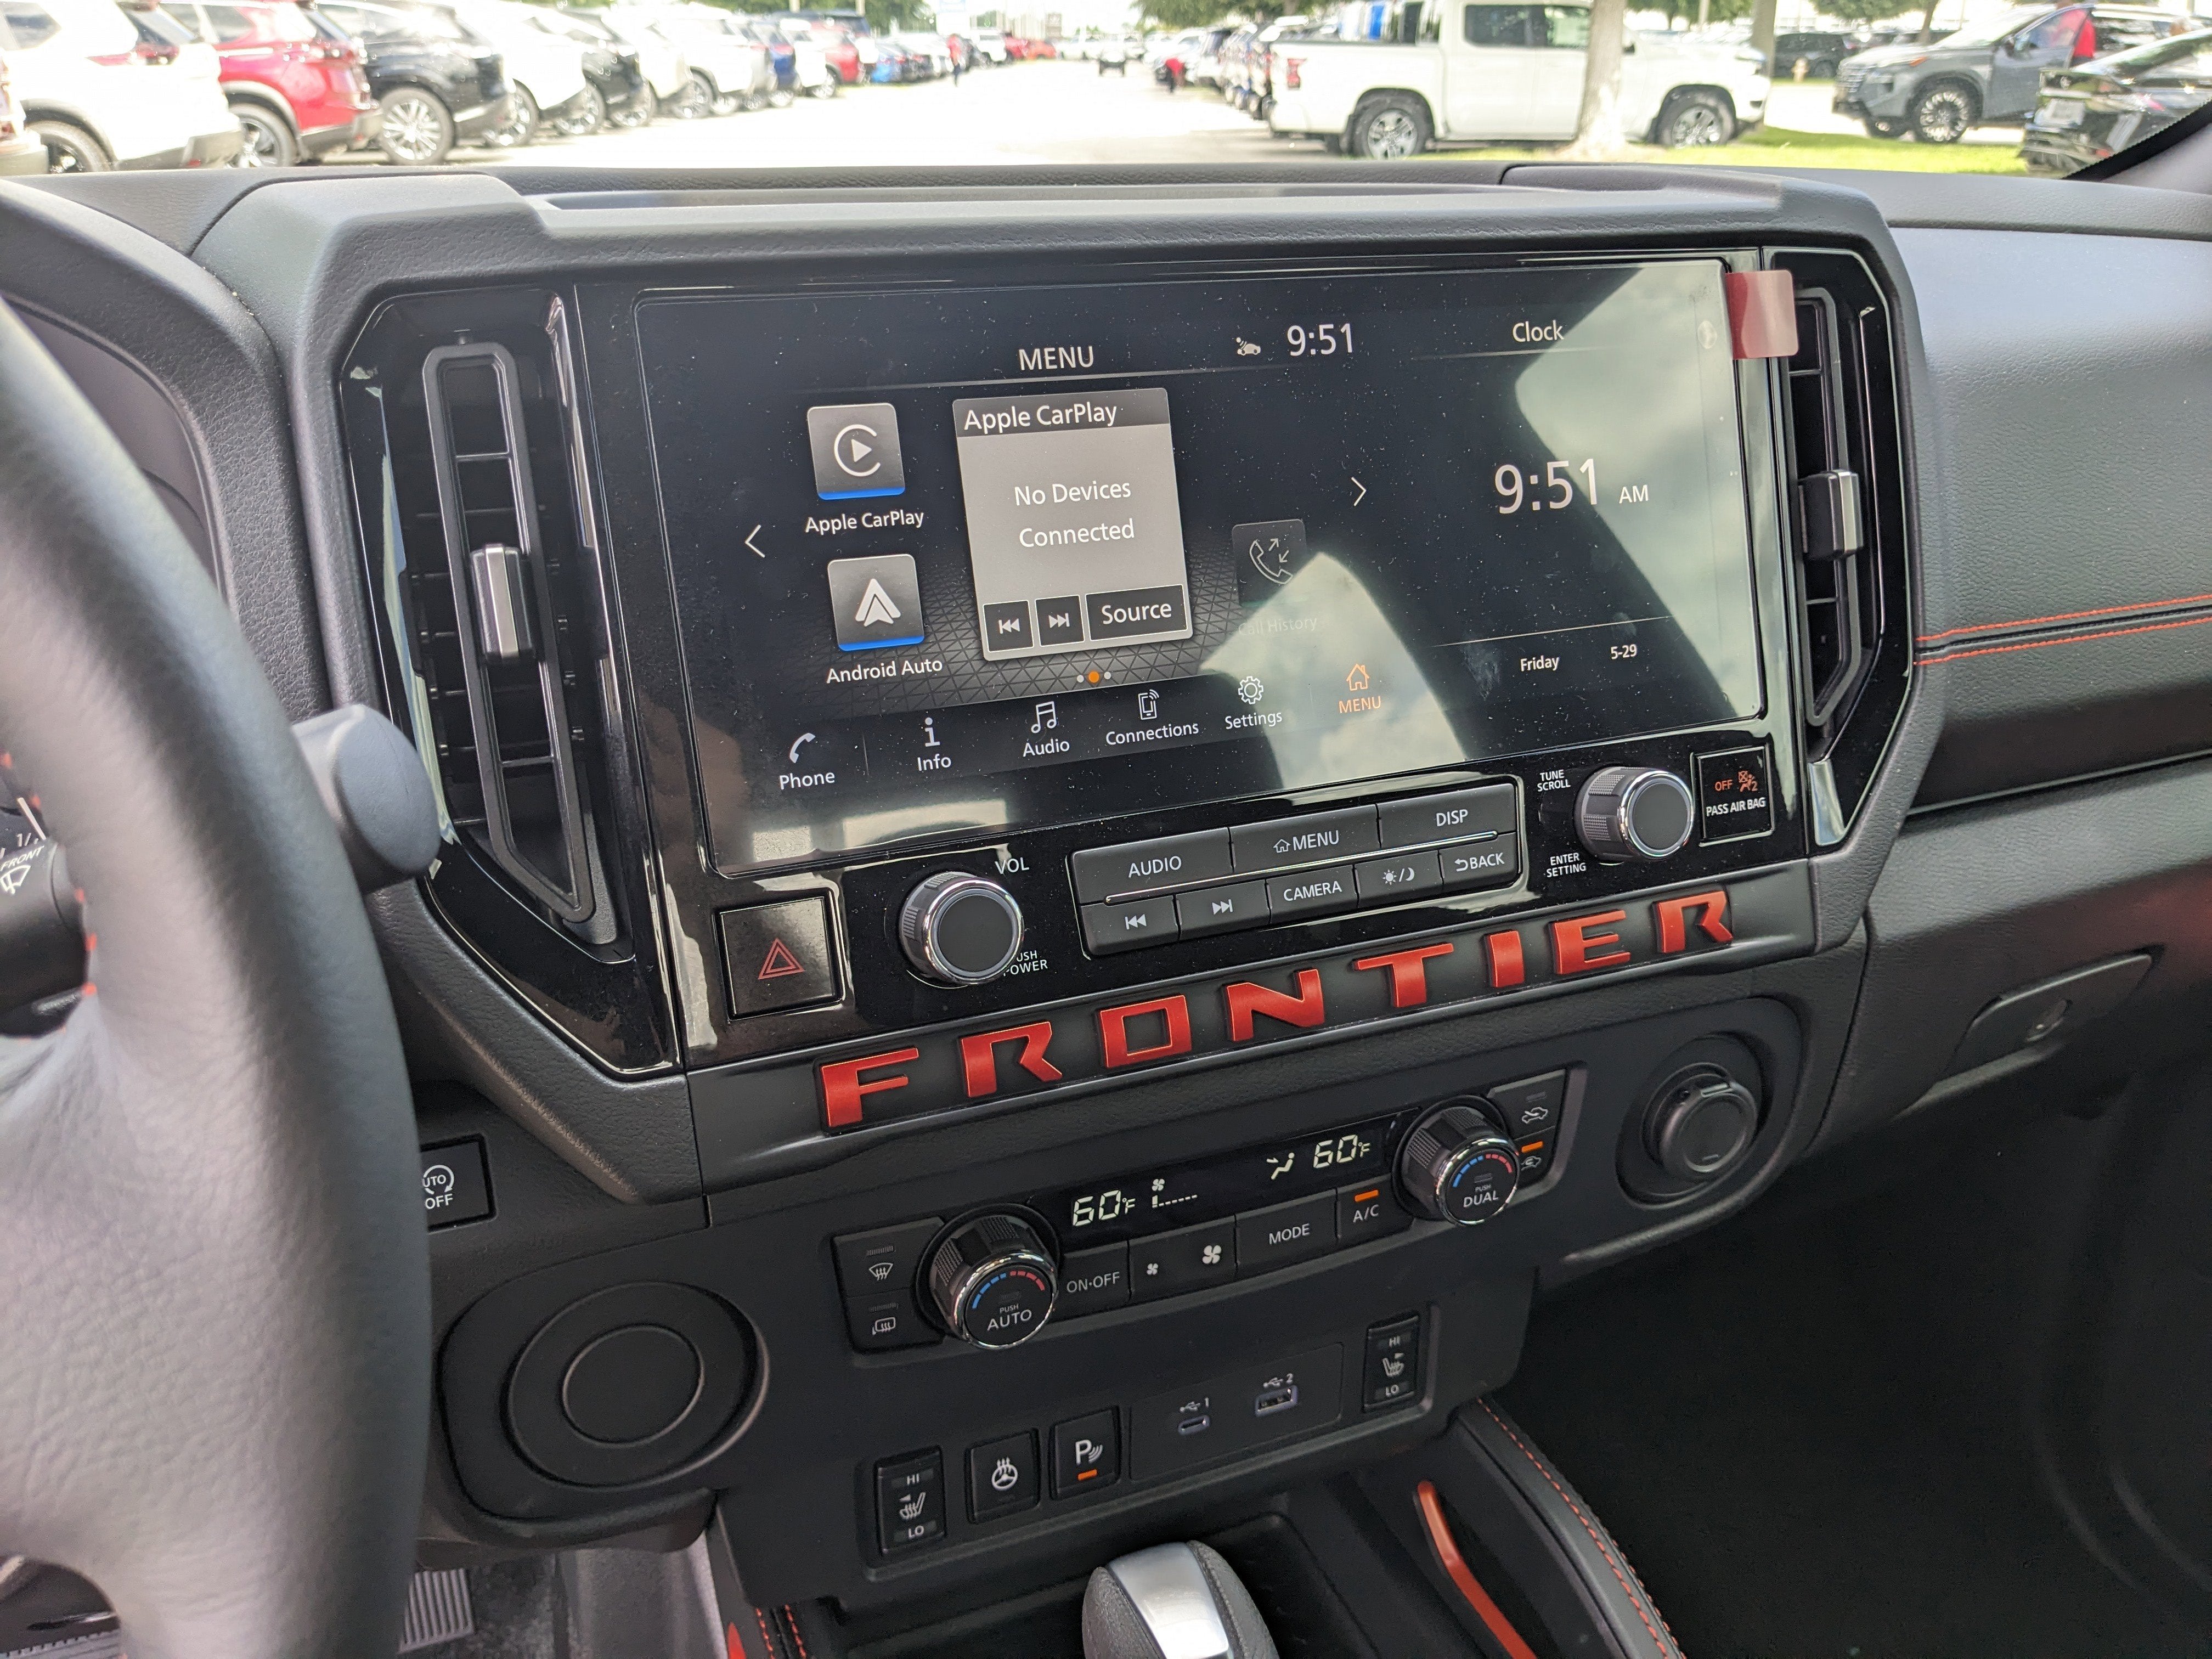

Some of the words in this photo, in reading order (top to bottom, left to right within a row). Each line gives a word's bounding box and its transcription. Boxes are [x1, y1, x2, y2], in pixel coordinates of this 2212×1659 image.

[1286, 323, 1355, 357] 9:51
[1513, 319, 1564, 343] Clock
[1019, 346, 1094, 371] MENU
[964, 405, 1031, 433] Apple
[1036, 402, 1117, 426] CarPlay
[1014, 486, 1046, 506] No
[1053, 481, 1131, 503] Devices
[1494, 458, 1599, 515] 9:51
[1618, 484, 1650, 504] AM
[805, 514, 857, 535] Apple
[861, 509, 924, 530] CarPlay
[1019, 518, 1135, 549] Connected
[1102, 600, 1172, 625] Source
[1611, 643, 1638, 660] 5-29
[826, 661, 898, 684] Android
[901, 659, 943, 676] Auto
[1520, 654, 1560, 673] Friday
[1338, 696, 1381, 714] MENU
[1224, 710, 1283, 731] Settings
[1105, 720, 1199, 746] Connections
[1023, 738, 1070, 757] Audio
[917, 754, 952, 771] Info
[779, 770, 836, 791] Phone
[1540, 769, 1565, 780] TUNE
[1537, 778, 1571, 792] SCROLL
[1714, 779, 1733, 792] OFF
[1706, 803, 1729, 817] PASS
[1730, 800, 1747, 813] AIR
[1747, 797, 1767, 810] BAG
[1436, 809, 1469, 827] DISP
[1293, 830, 1340, 850] MENU
[0, 845, 45, 871] FRONT
[995, 857, 1030, 874] VOL
[1128, 855, 1182, 878] AUDIO
[1469, 852, 1505, 870] BACK
[1550, 852, 1580, 866] ENTER
[1546, 863, 1587, 878] SETTING
[1283, 880, 1342, 902] CAMERA
[1017, 950, 1037, 962] USH
[820, 890, 1733, 1128] FRONTIER
[422, 1174, 447, 1187] UTO
[425, 1193, 453, 1209] OFF
[1463, 1189, 1499, 1207] DUAL
[1353, 1204, 1380, 1223] A/C
[1268, 1222, 1311, 1245] MODE
[1000, 1302, 1019, 1314] PUSH
[987, 1308, 1032, 1331] AUTO
[1389, 1335, 1401, 1348] HI
[1286, 1373, 1294, 1384] 2
[1385, 1384, 1400, 1397] LO
[1075, 1439, 1092, 1466] P
[906, 1472, 920, 1486] HI
[908, 1525, 924, 1539] LO
